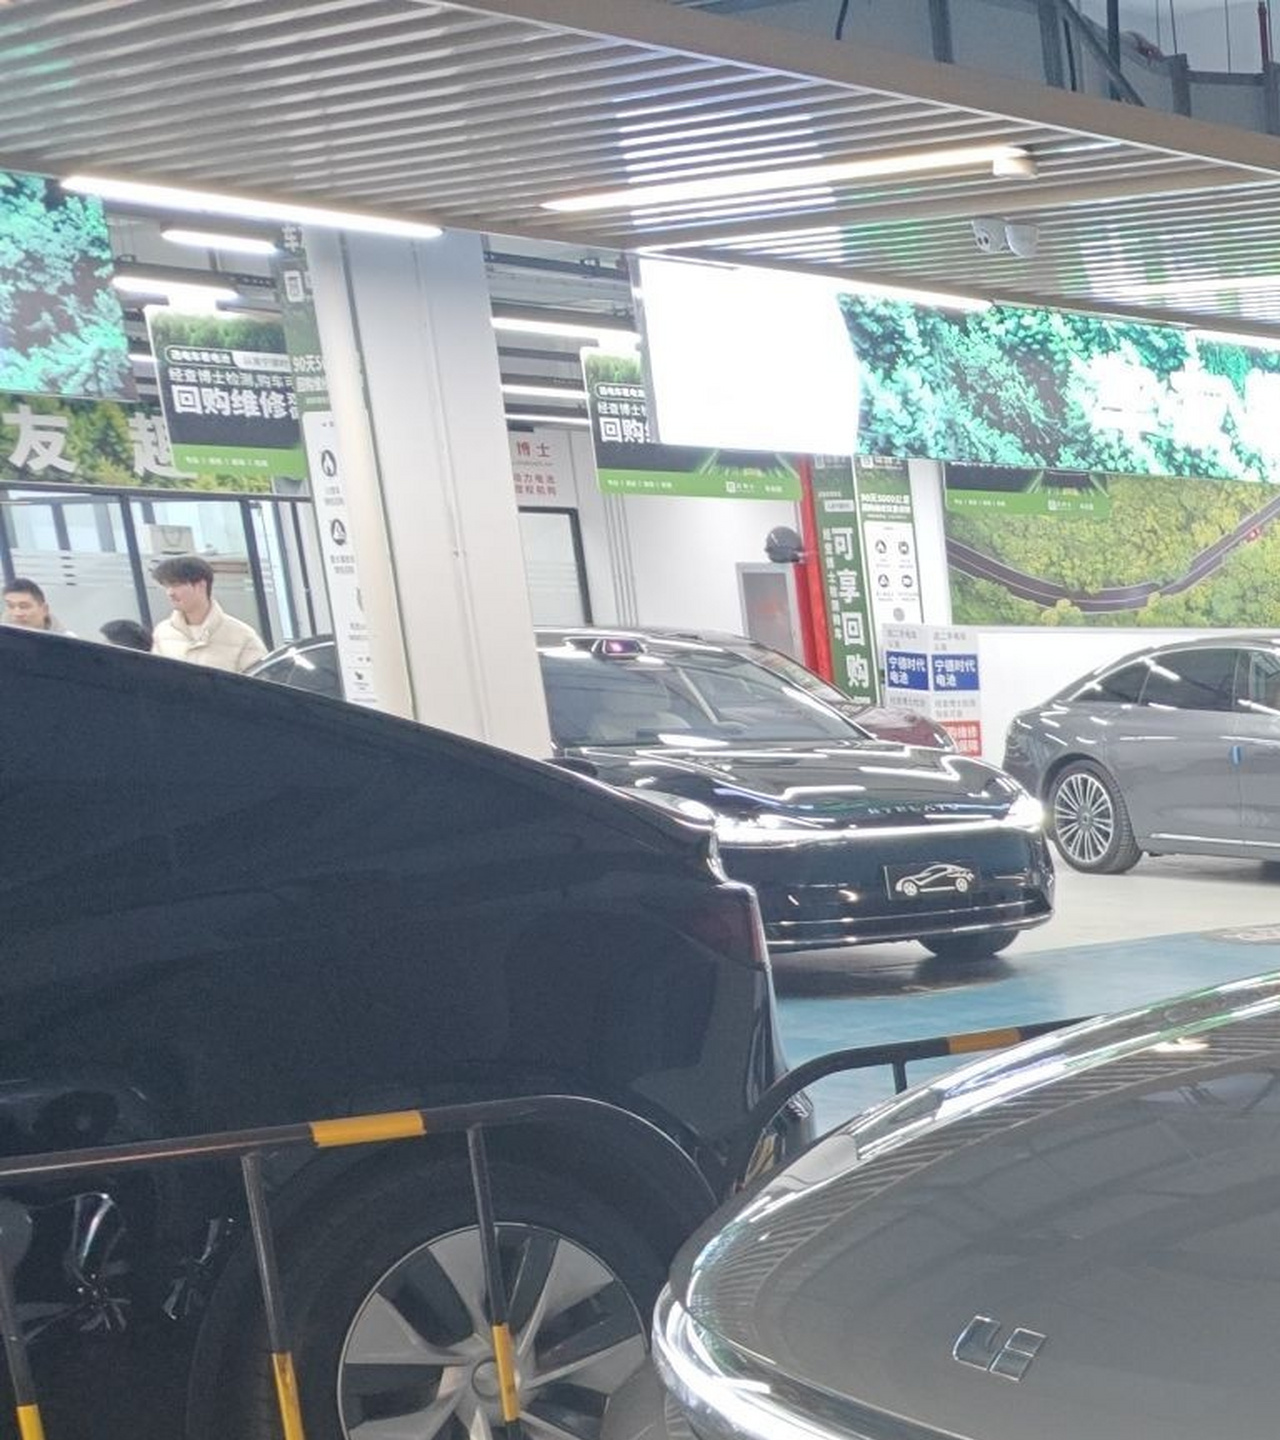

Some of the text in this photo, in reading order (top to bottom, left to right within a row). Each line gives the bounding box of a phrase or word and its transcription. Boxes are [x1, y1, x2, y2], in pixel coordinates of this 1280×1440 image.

[888, 656, 926, 672] 宁德时代
[934, 659, 976, 673] 宁德时代
[889, 670, 909, 685] 电池
[936, 673, 957, 687] 电池
